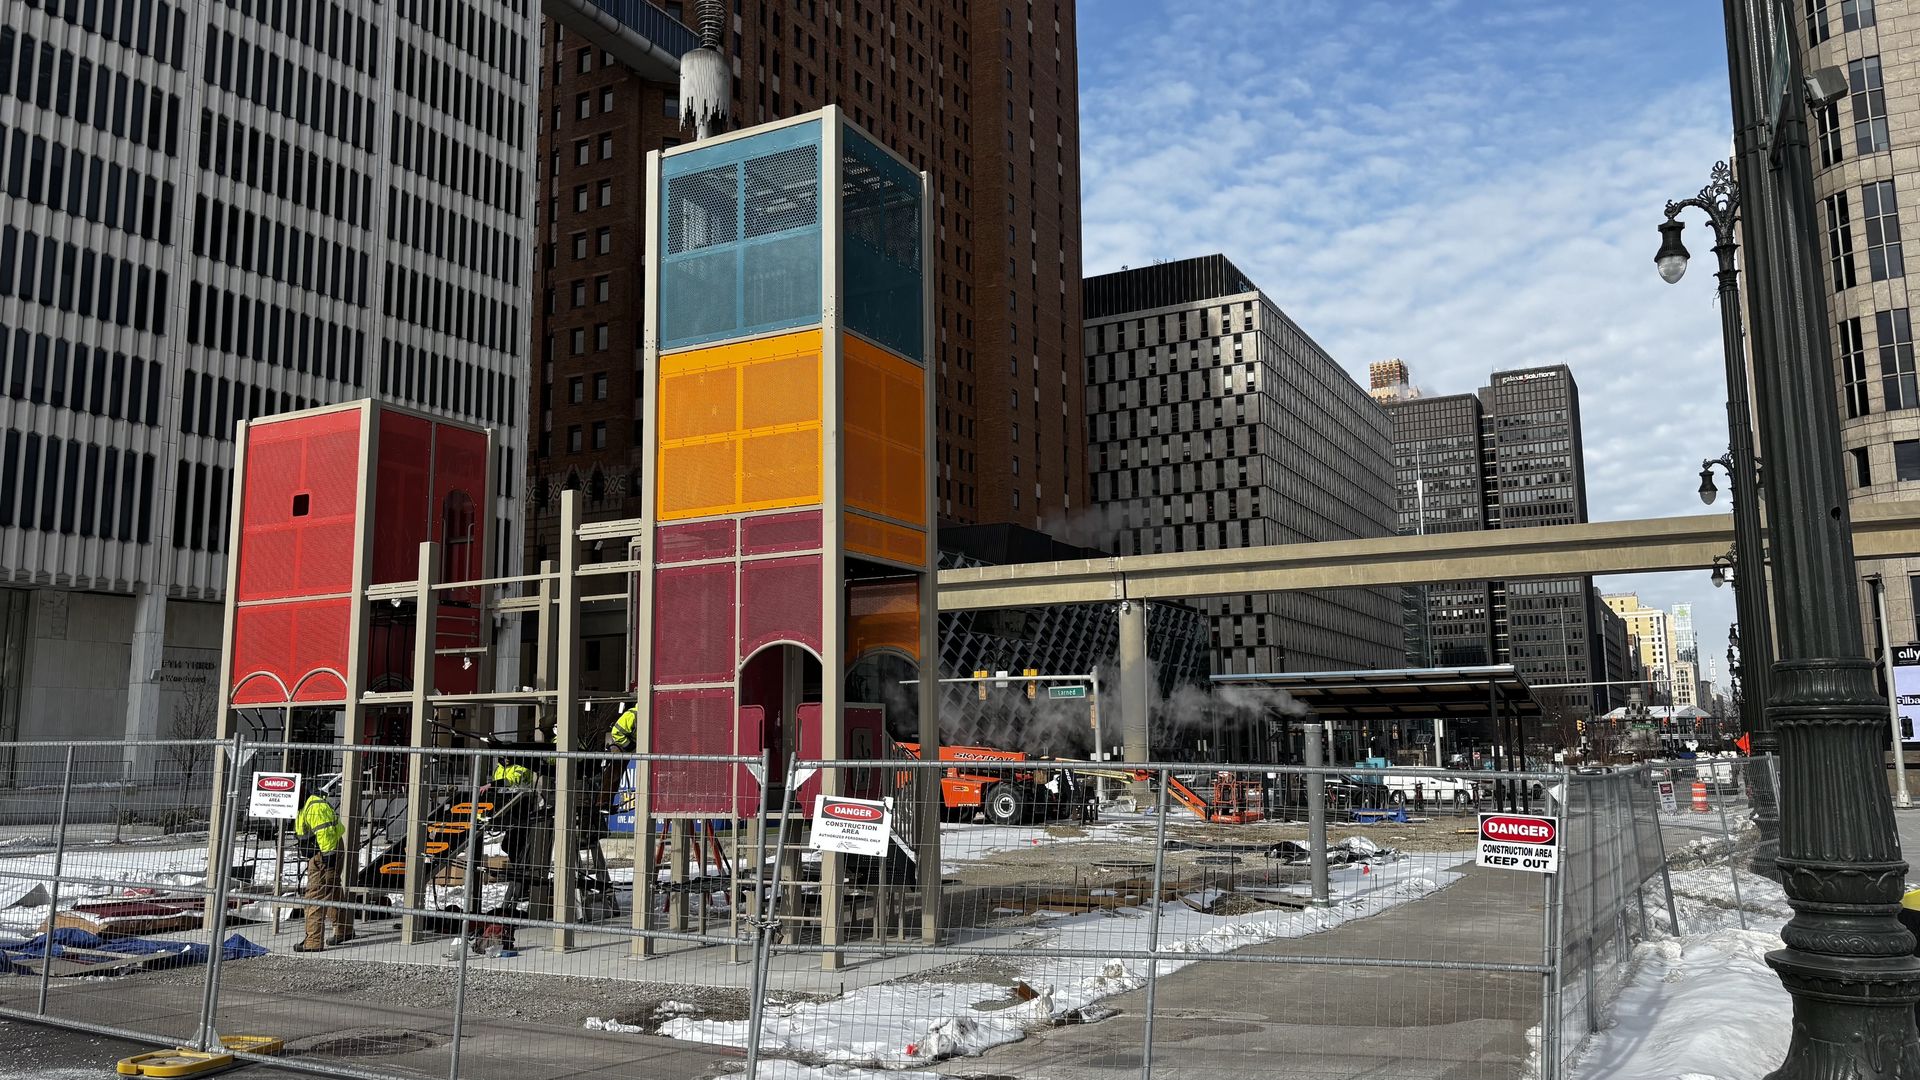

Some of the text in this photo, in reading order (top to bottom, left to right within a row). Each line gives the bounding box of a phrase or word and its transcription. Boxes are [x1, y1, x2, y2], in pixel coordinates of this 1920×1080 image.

[1898, 648, 1920, 661] ally
[954, 752, 1016, 761] SKYTRAK
[264, 780, 289, 788] DANGER
[834, 806, 872, 817] DANGER
[825, 820, 878, 831] CONSTRUCTION
[1488, 822, 1549, 837] DANGER
[1482, 844, 1552, 858] CONSTRUCTION AREA
[1484, 855, 1549, 869] KEEP OUT
